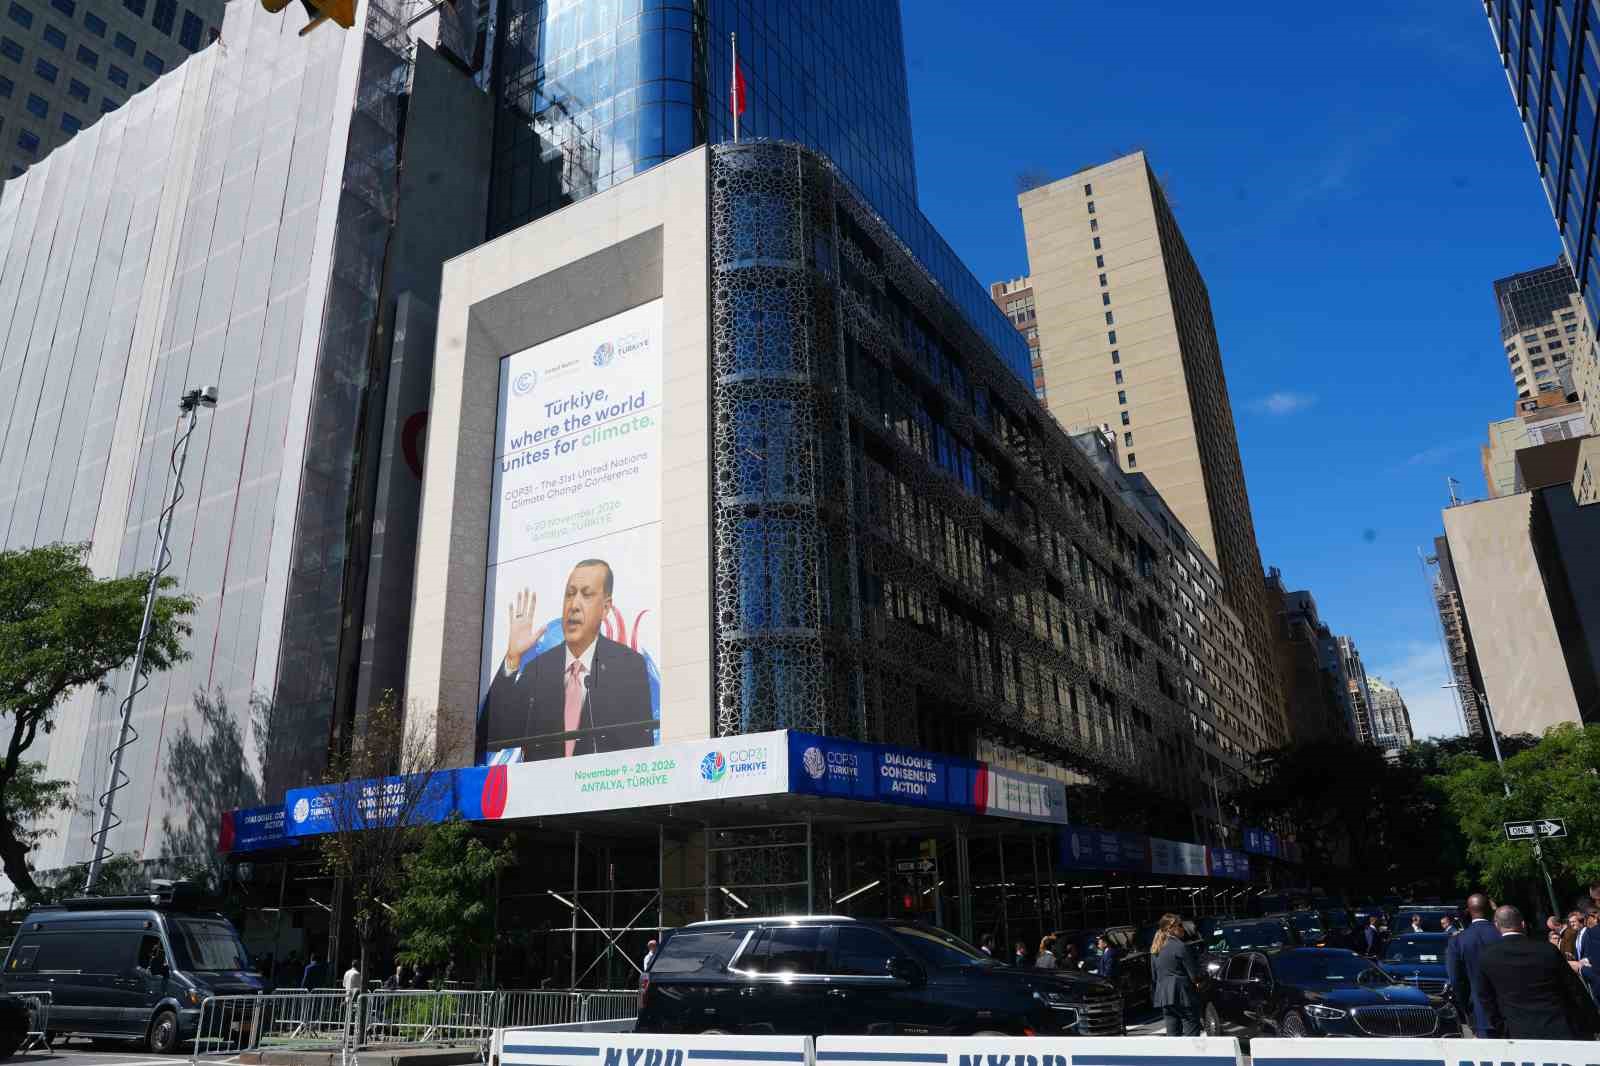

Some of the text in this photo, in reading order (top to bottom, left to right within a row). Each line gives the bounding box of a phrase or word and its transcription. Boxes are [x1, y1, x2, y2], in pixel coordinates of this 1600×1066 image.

[544, 389, 608, 418] Türkiye,
[510, 392, 646, 450] where the world
[499, 415, 655, 472] unites for climate.
[541, 479, 556, 490] The
[578, 464, 608, 480] United
[610, 452, 648, 471] Nations
[511, 467, 639, 510] Climate Change Conference
[574, 765, 620, 781] November
[621, 765, 628, 775] 9
[651, 759, 676, 771] 2026
[885, 752, 933, 770] DIALOGUE
[580, 779, 625, 793] ANTALYA,
[881, 766, 937, 784] CONSENSUS
[892, 780, 927, 795] ACTION
[1512, 825, 1529, 835] ONE
